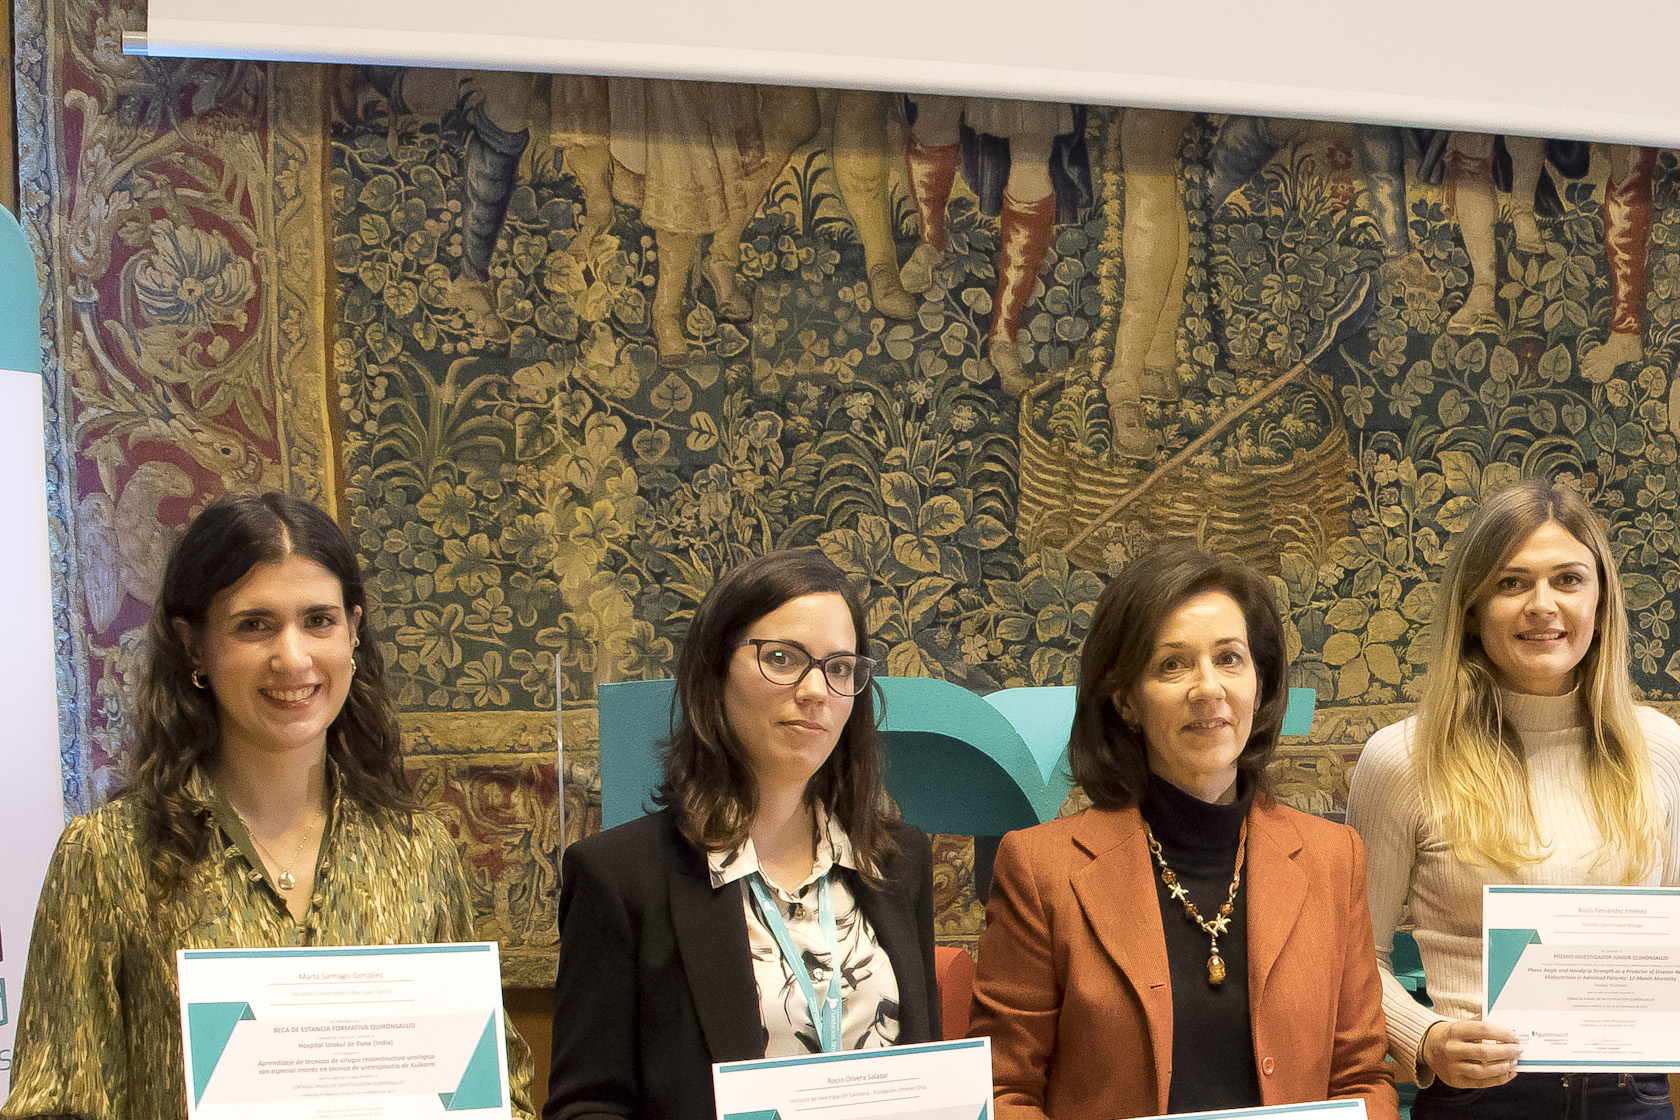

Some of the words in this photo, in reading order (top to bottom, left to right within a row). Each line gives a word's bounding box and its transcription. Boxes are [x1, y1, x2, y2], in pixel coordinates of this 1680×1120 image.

[298, 973, 320, 981] Marta
[321, 972, 352, 982] Santiago
[352, 971, 384, 980] González
[300, 1025, 331, 1033] ESTANCIA
[332, 1024, 369, 1032] FORMATIVA
[298, 1042, 324, 1050] Hospital
[372, 1039, 394, 1047] (India)
[257, 1059, 295, 1069] Aprendizaje
[330, 1057, 339, 1065] de
[270, 1067, 297, 1076] especial
[845, 1073, 867, 1083] Olivera
[867, 1071, 889, 1081] Salazar
